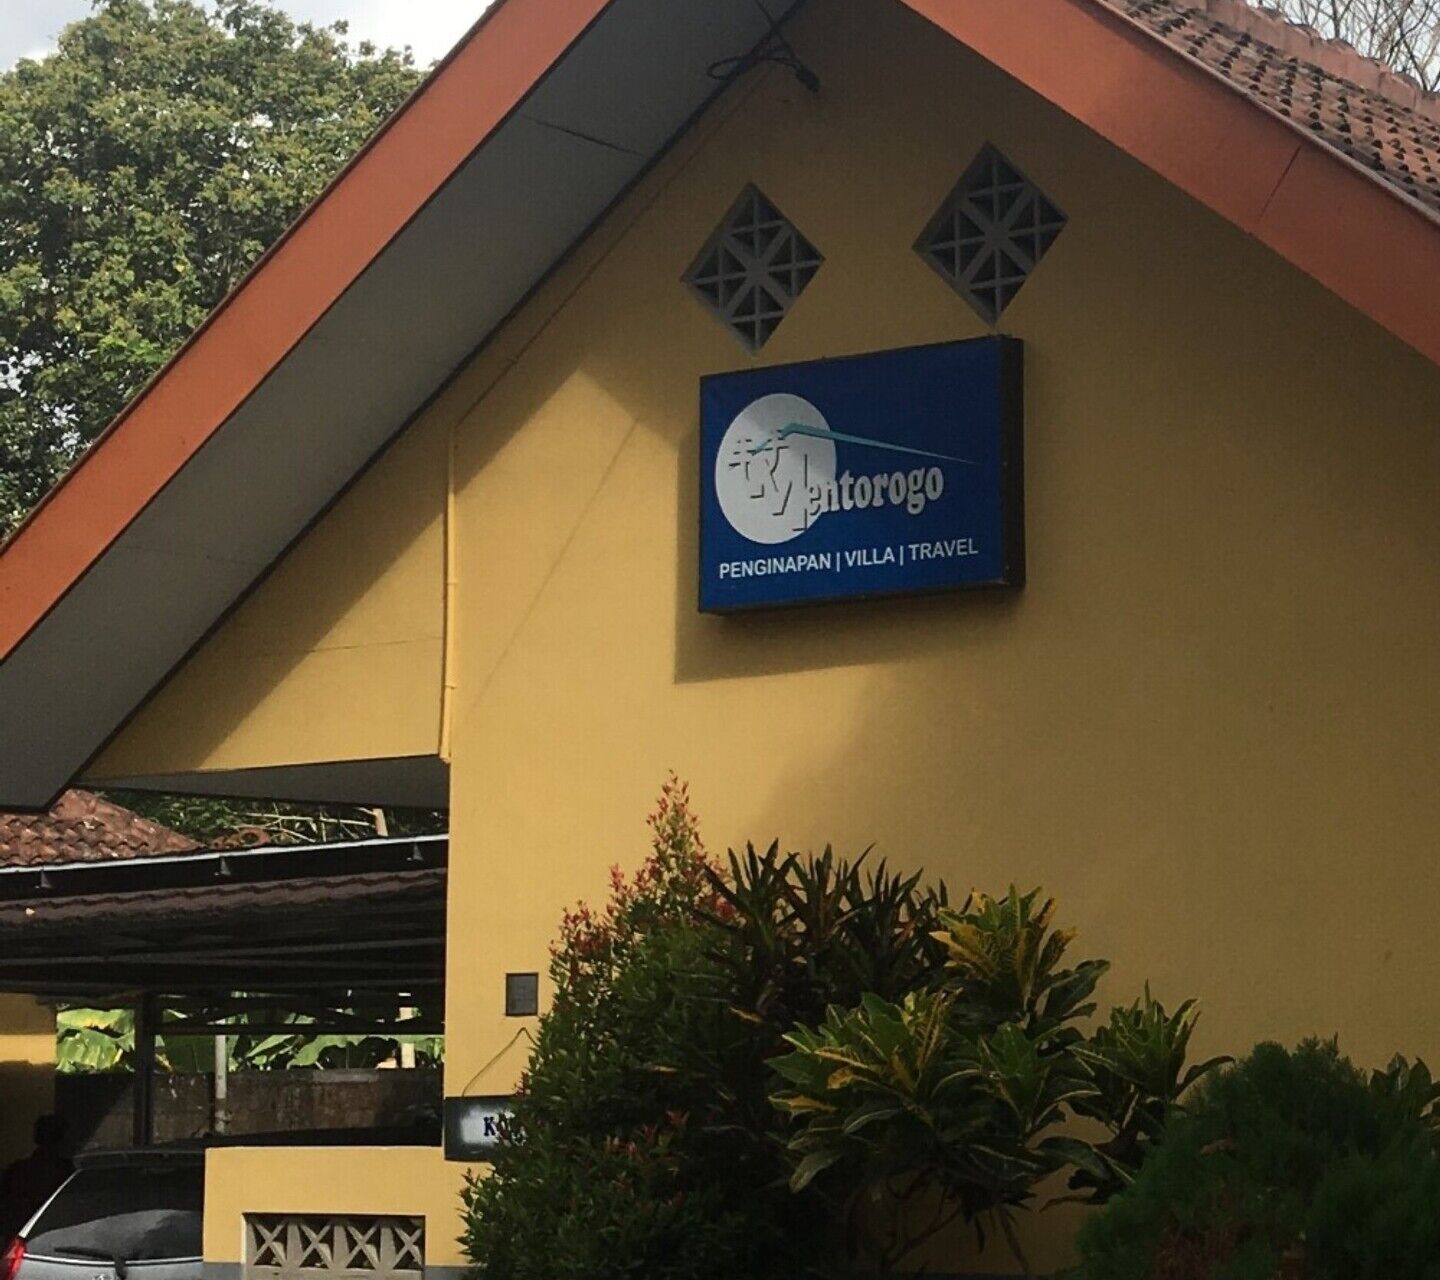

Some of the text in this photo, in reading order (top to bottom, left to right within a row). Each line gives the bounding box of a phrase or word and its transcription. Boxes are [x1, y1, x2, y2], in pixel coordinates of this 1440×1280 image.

[729, 433, 944, 531] Mentorogo
[719, 553, 832, 579] PENGINAPAN
[845, 547, 896, 567] VILLA
[908, 538, 979, 561] TRAVEL
